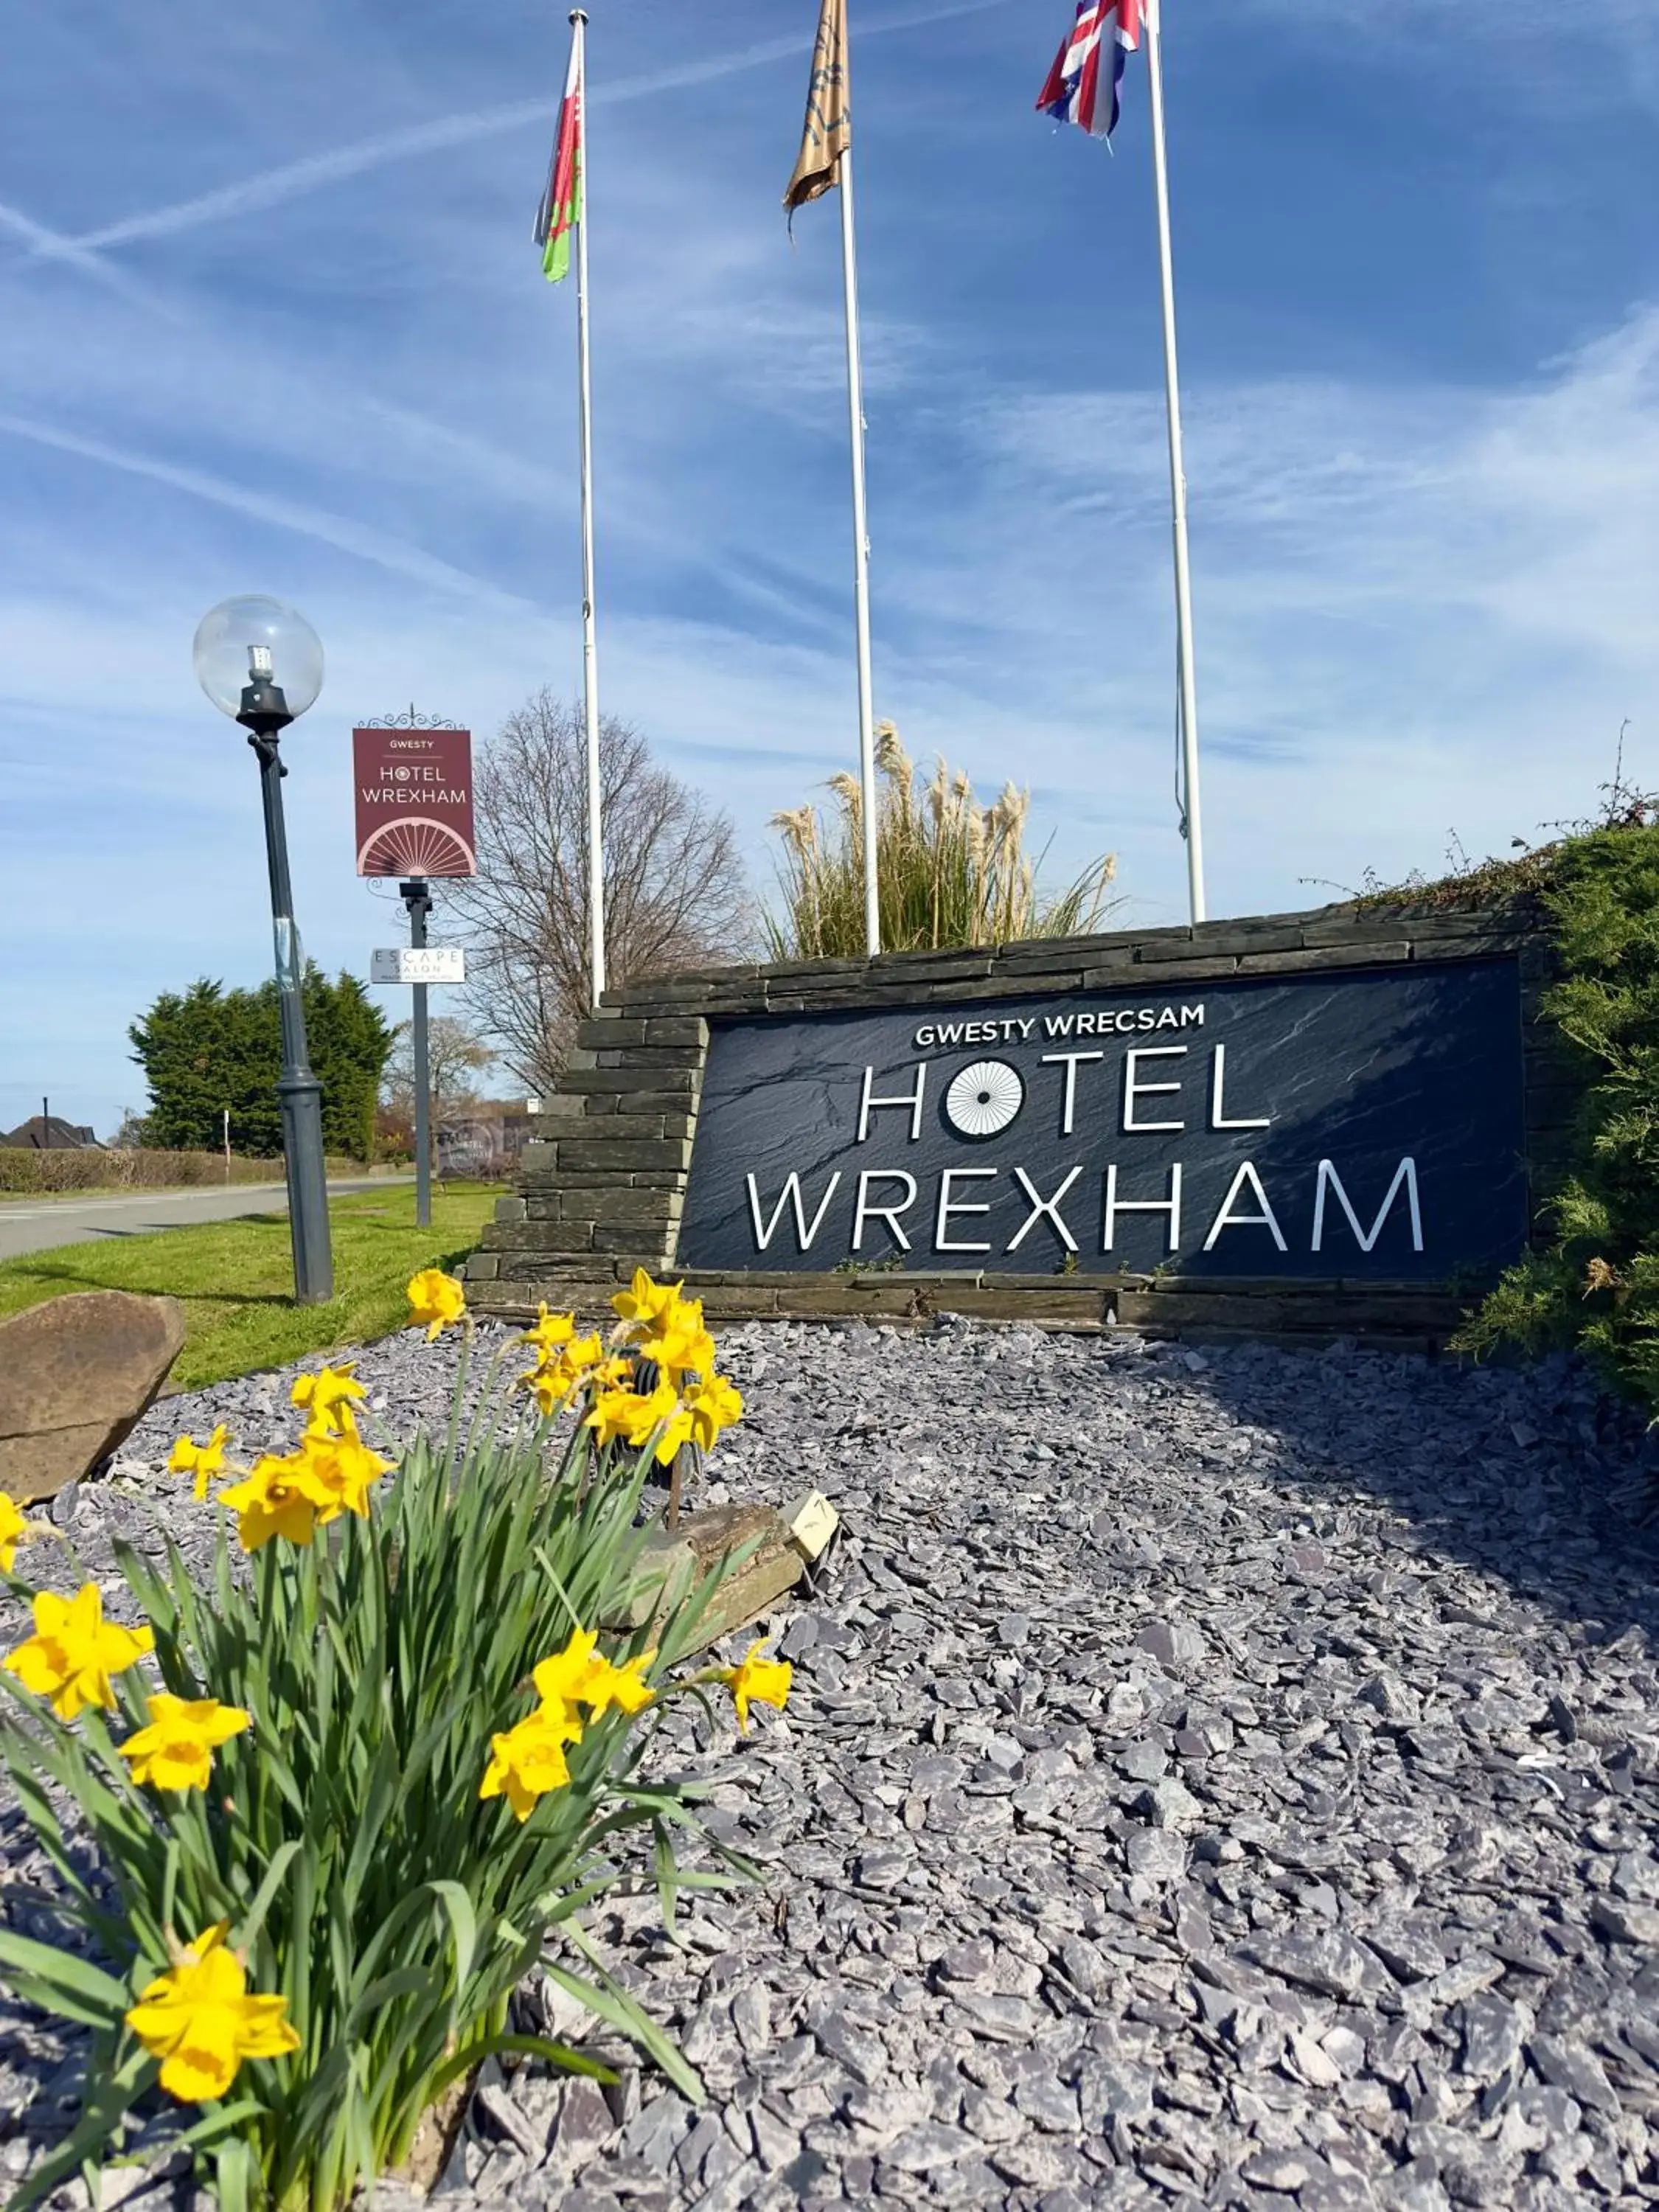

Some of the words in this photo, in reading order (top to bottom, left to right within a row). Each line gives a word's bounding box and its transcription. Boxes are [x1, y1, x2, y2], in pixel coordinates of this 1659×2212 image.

[389, 740, 434, 749] GWESTY
[380, 766, 446, 782] HOTEL
[362, 787, 466, 803] WREXHAM
[375, 950, 459, 963] ESCAPE
[390, 964, 441, 973] SALON
[914, 1018, 1036, 1046] GWESTY
[1044, 1004, 1205, 1037] WRECSAM
[858, 1043, 1270, 1142] HOTEL
[746, 1156, 1425, 1253] WREXHAM
